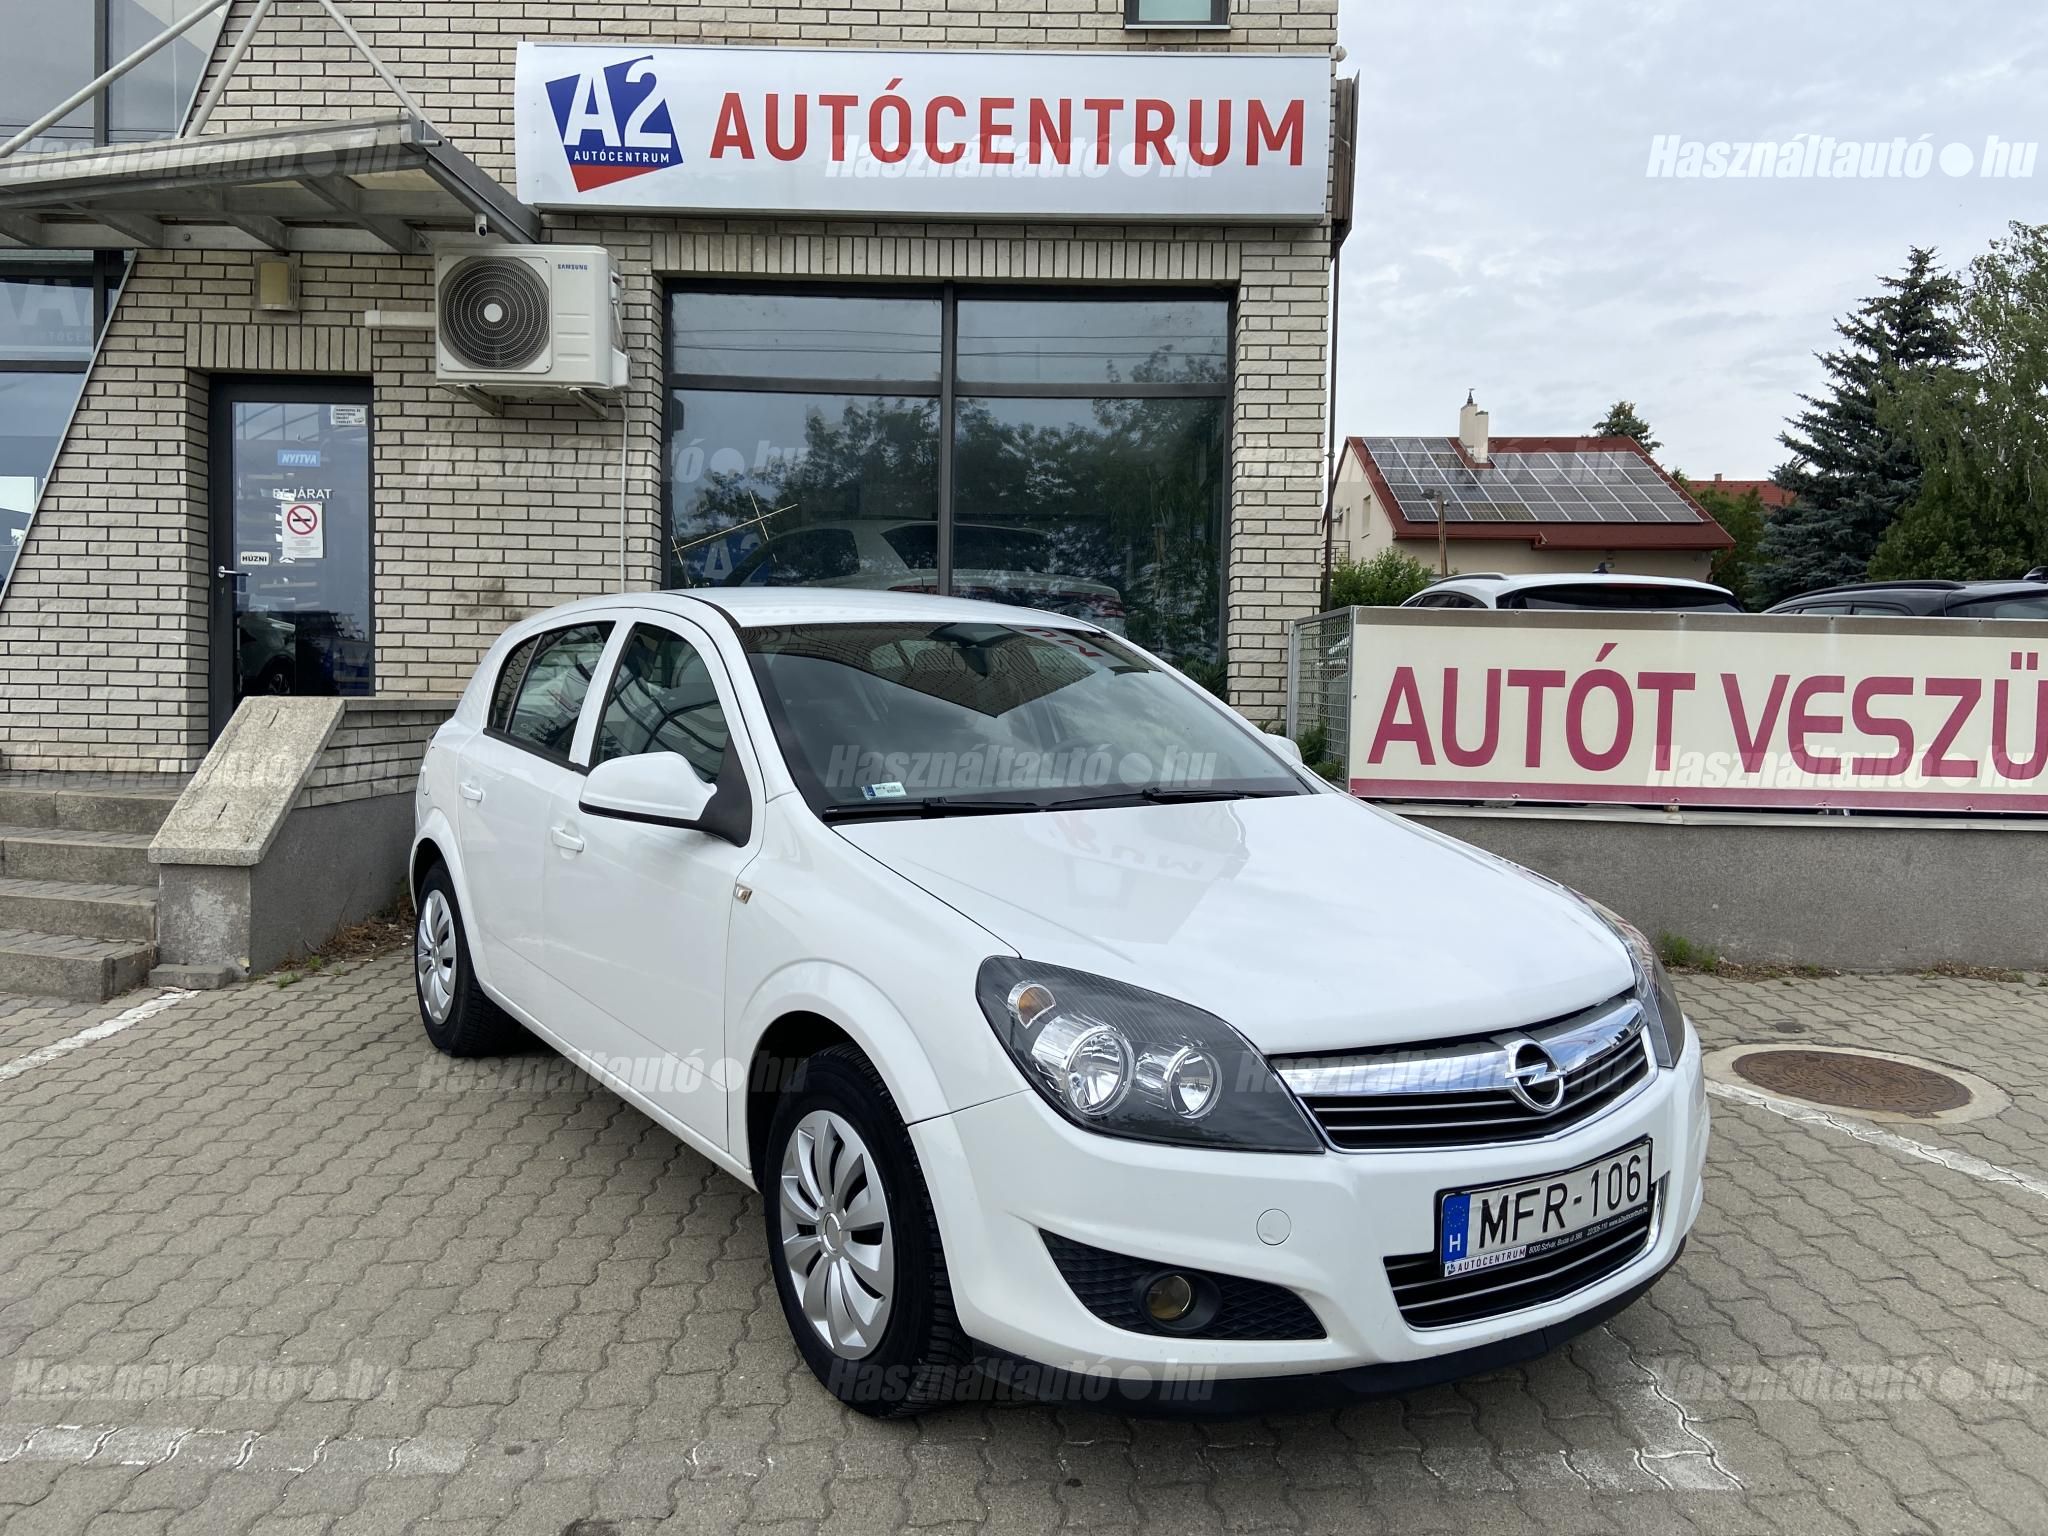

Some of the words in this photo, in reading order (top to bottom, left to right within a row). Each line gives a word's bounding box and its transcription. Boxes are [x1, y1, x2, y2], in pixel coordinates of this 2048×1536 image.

[562, 56, 672, 149] A2
[709, 78, 1305, 166] AUTÓCENTRUM
[573, 145, 671, 164] AUTÓCENTRUM
[557, 263, 588, 271] SAMSUNG
[281, 453, 317, 465] NYITVA
[272, 486, 333, 500] BEJÁRAT
[242, 554, 267, 562] HÚZNI
[1367, 642, 1696, 771] AUTÓT
[1478, 1154, 1642, 1249] MFR-106
[1449, 1233, 1461, 1253] H
[1457, 1248, 1526, 1273] AUTÓCENTRUM
